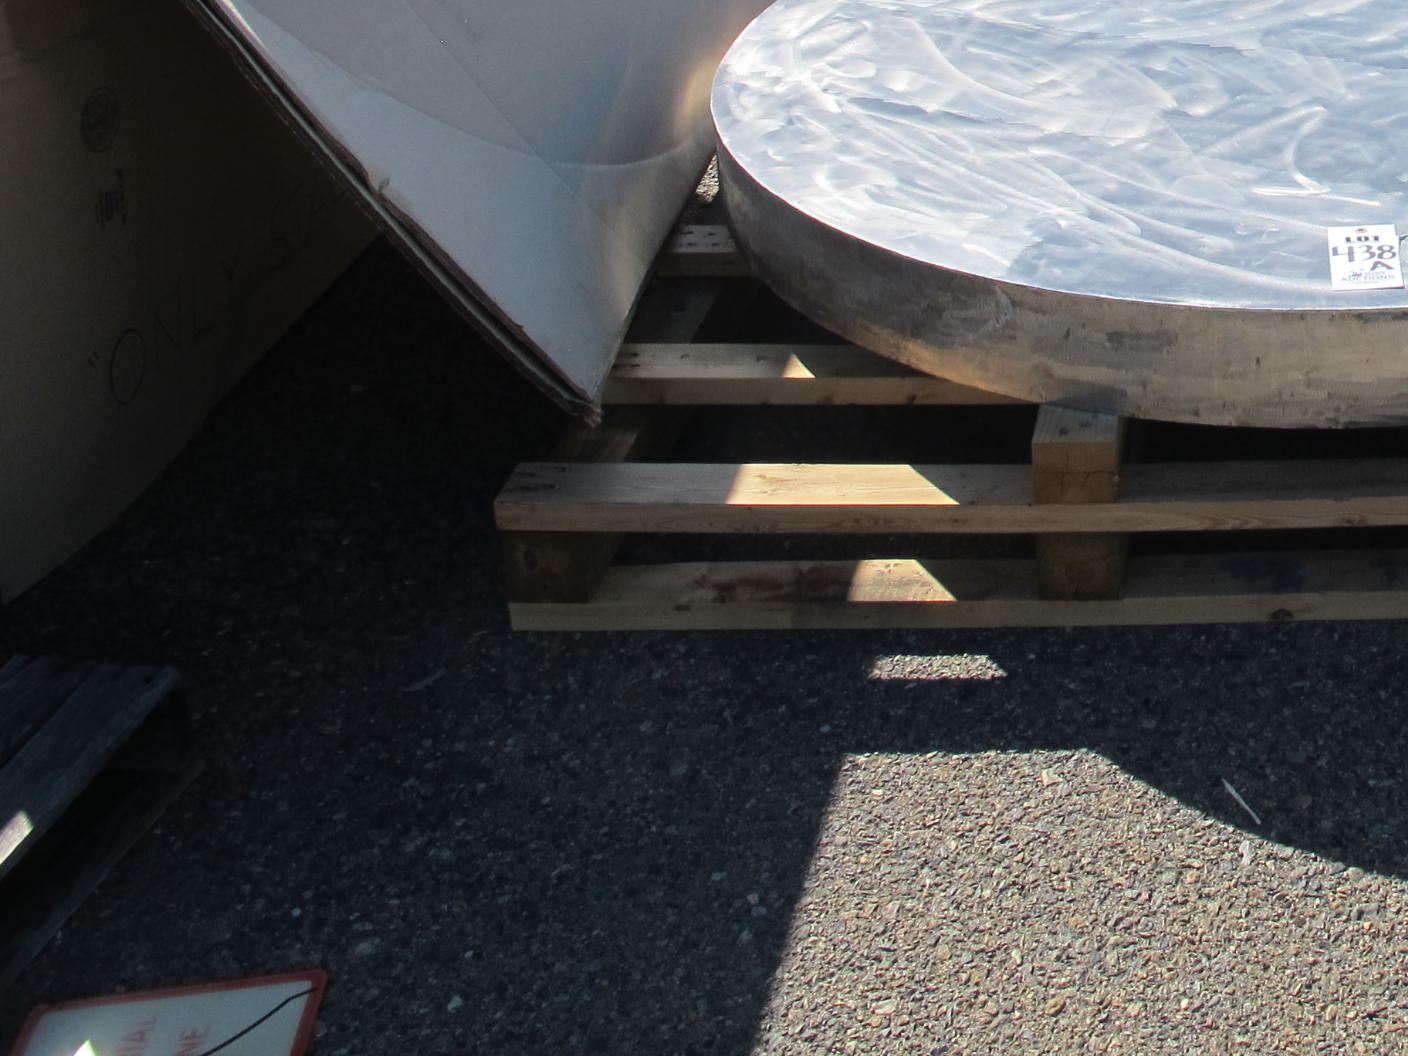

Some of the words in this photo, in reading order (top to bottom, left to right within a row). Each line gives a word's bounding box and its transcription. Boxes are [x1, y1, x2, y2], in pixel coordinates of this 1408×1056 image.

[1344, 235, 1380, 243] LOT
[1331, 244, 1397, 262] 438
[1369, 260, 1394, 271] A
